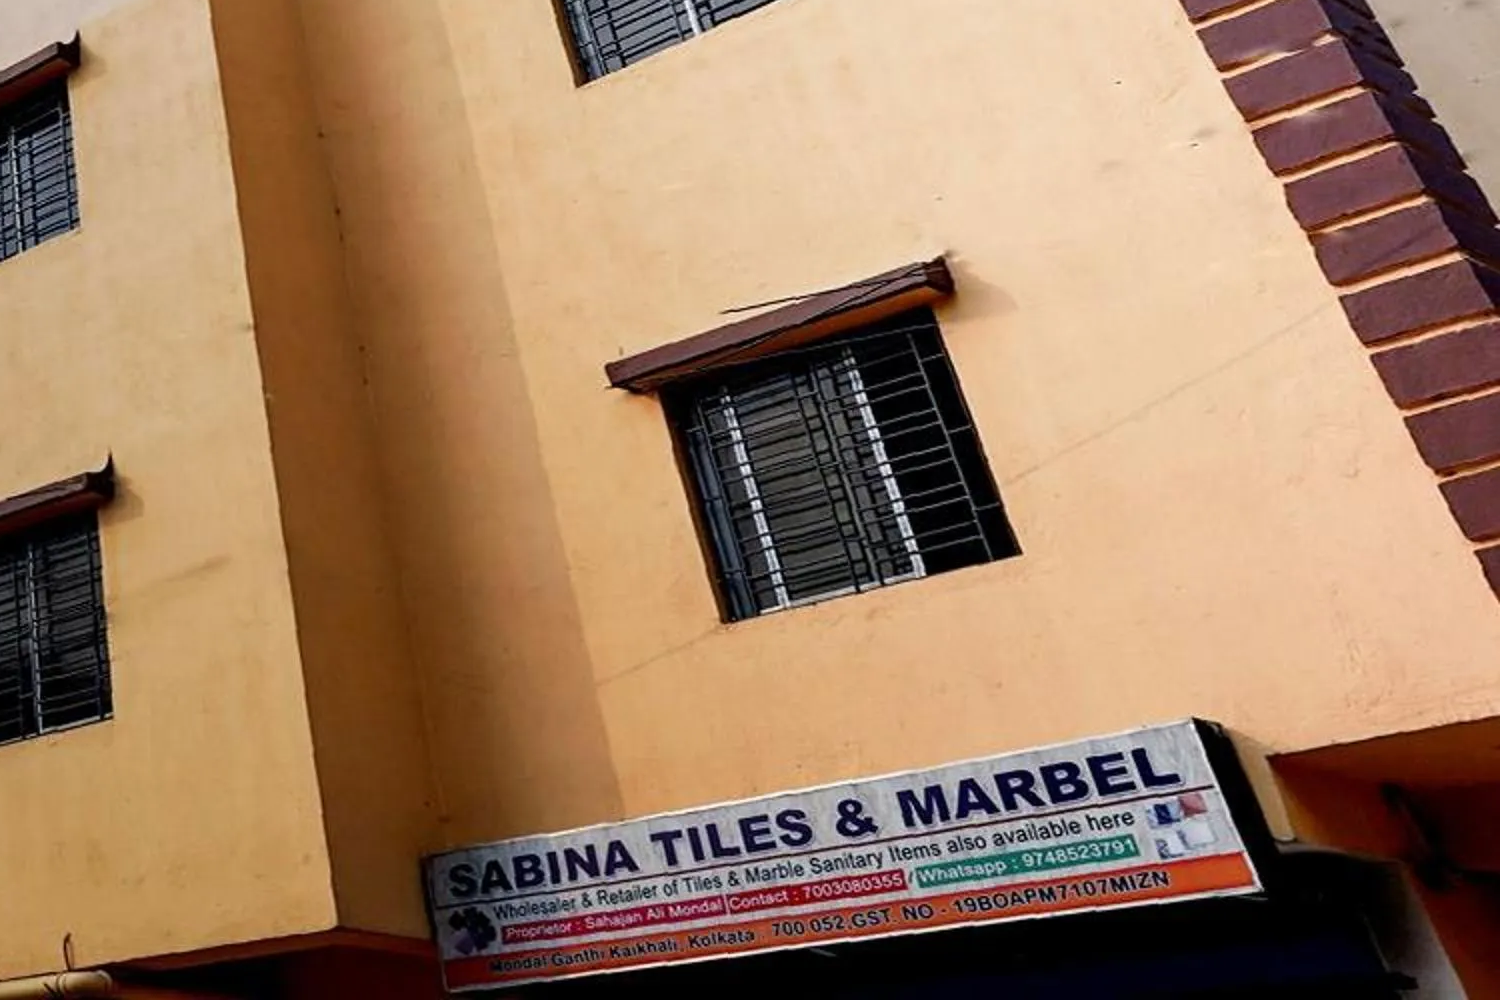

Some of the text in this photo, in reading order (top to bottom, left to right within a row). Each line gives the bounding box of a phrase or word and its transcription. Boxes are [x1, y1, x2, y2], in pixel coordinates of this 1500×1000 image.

[449, 747, 1182, 897] SABINA TILES & MARBEL
[494, 898, 576, 921] Wholesaler
[597, 884, 659, 907] Retailer
[663, 878, 680, 898] of
[681, 874, 723, 894] Tiles
[727, 870, 741, 887] &
[744, 861, 805, 885] Marble
[809, 849, 883, 876] Sanitary
[887, 840, 942, 863] Items
[946, 835, 988, 854] also
[992, 819, 1081, 847] available
[1085, 811, 1135, 832] here
[506, 922, 572, 939] Proprietor
[668, 896, 723, 918] Mondal
[729, 889, 790, 911] Contact
[920, 861, 1008, 884] Whatsapp
[687, 929, 756, 949] Kolkata
[771, 920, 805, 937] 700
[902, 903, 934, 921] NO
